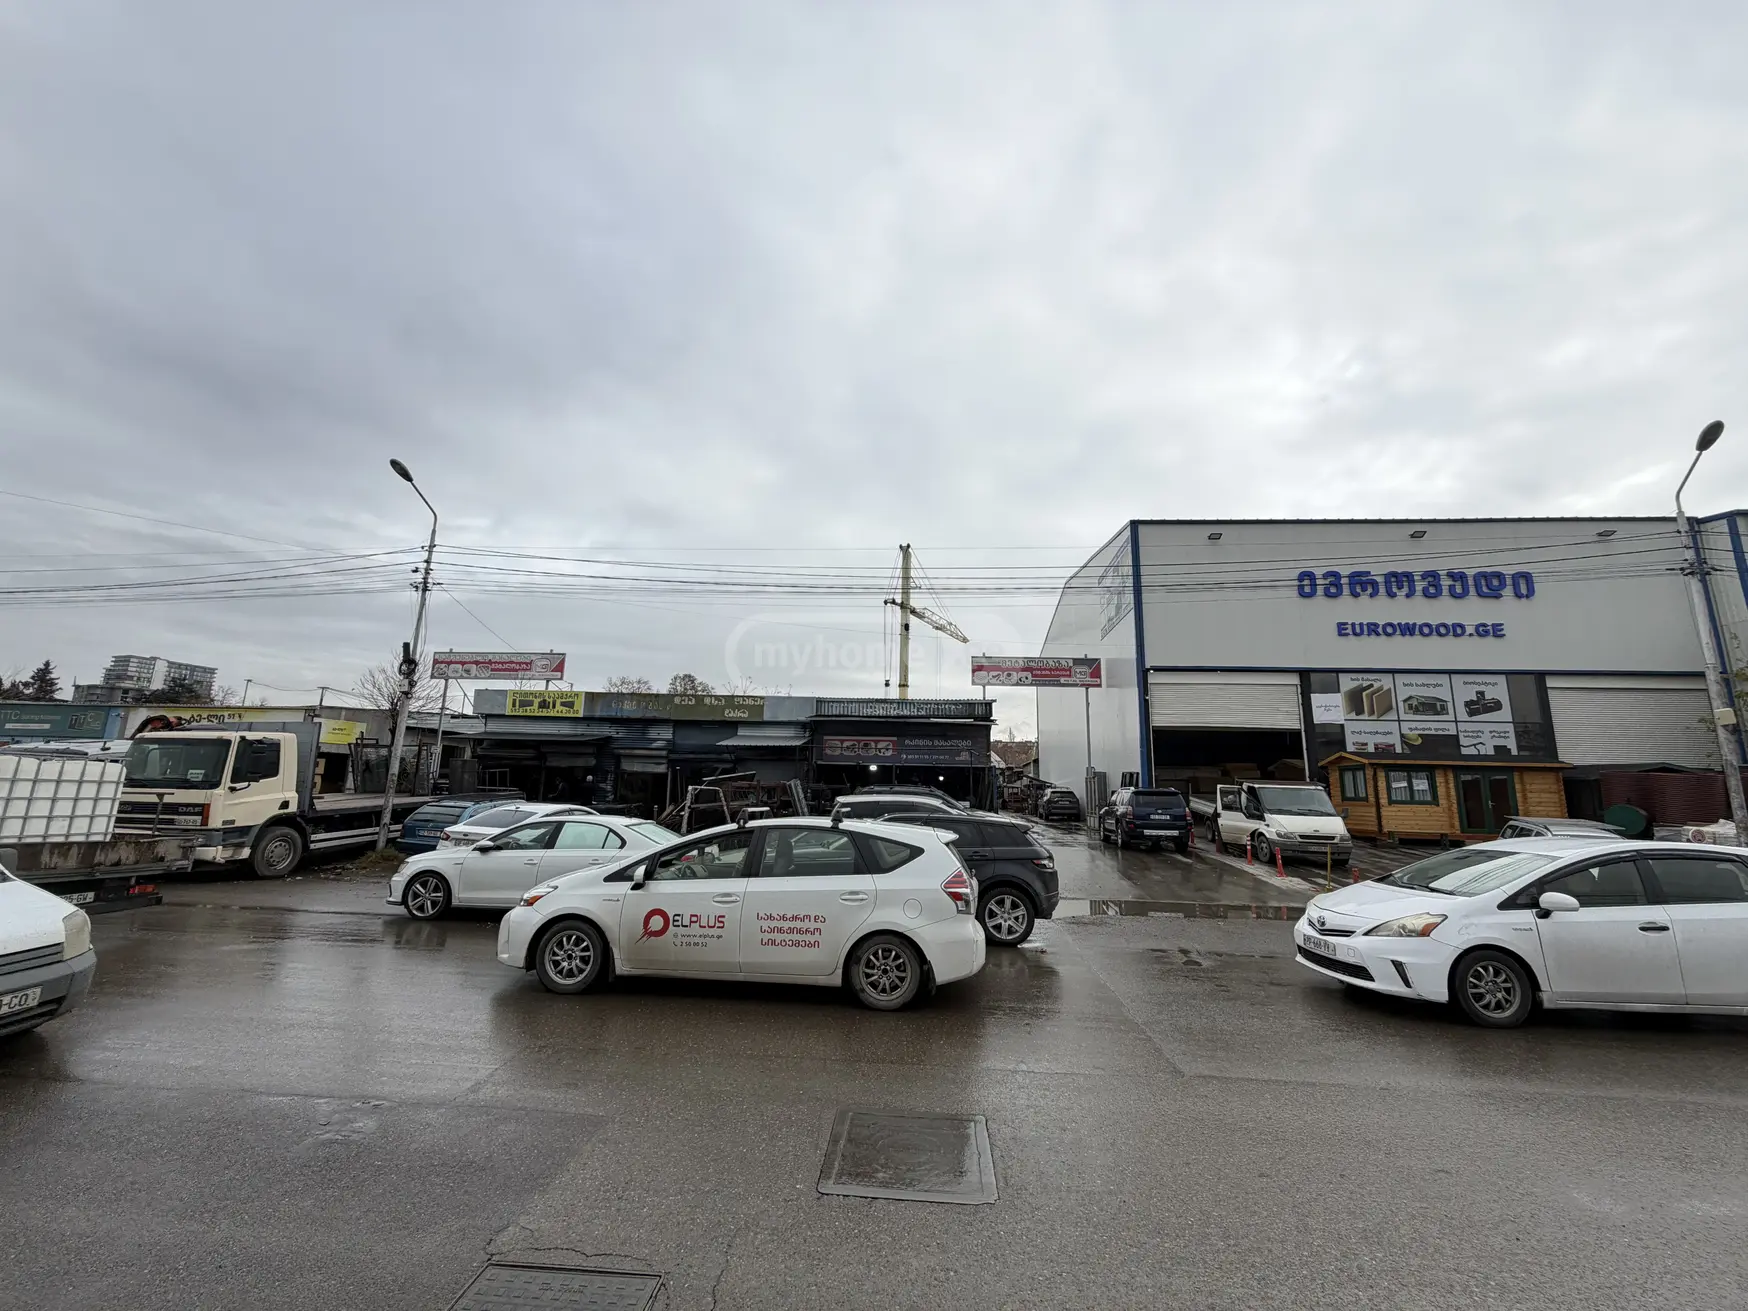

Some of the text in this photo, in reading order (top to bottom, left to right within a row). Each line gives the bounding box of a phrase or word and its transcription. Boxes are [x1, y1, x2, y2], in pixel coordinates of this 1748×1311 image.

[1297, 570, 1536, 599] ევროვუდი
[1336, 621, 1506, 638] EUROWOOD.GE
[1001, 659, 1071, 668] მეტალობაზა
[934, 739, 972, 747] მასალები
[672, 913, 726, 929] ELPLUS
[756, 912, 827, 923] სახანძრო და
[760, 926, 822, 936] საინჟინრო
[760, 938, 820, 948] სისტემები
